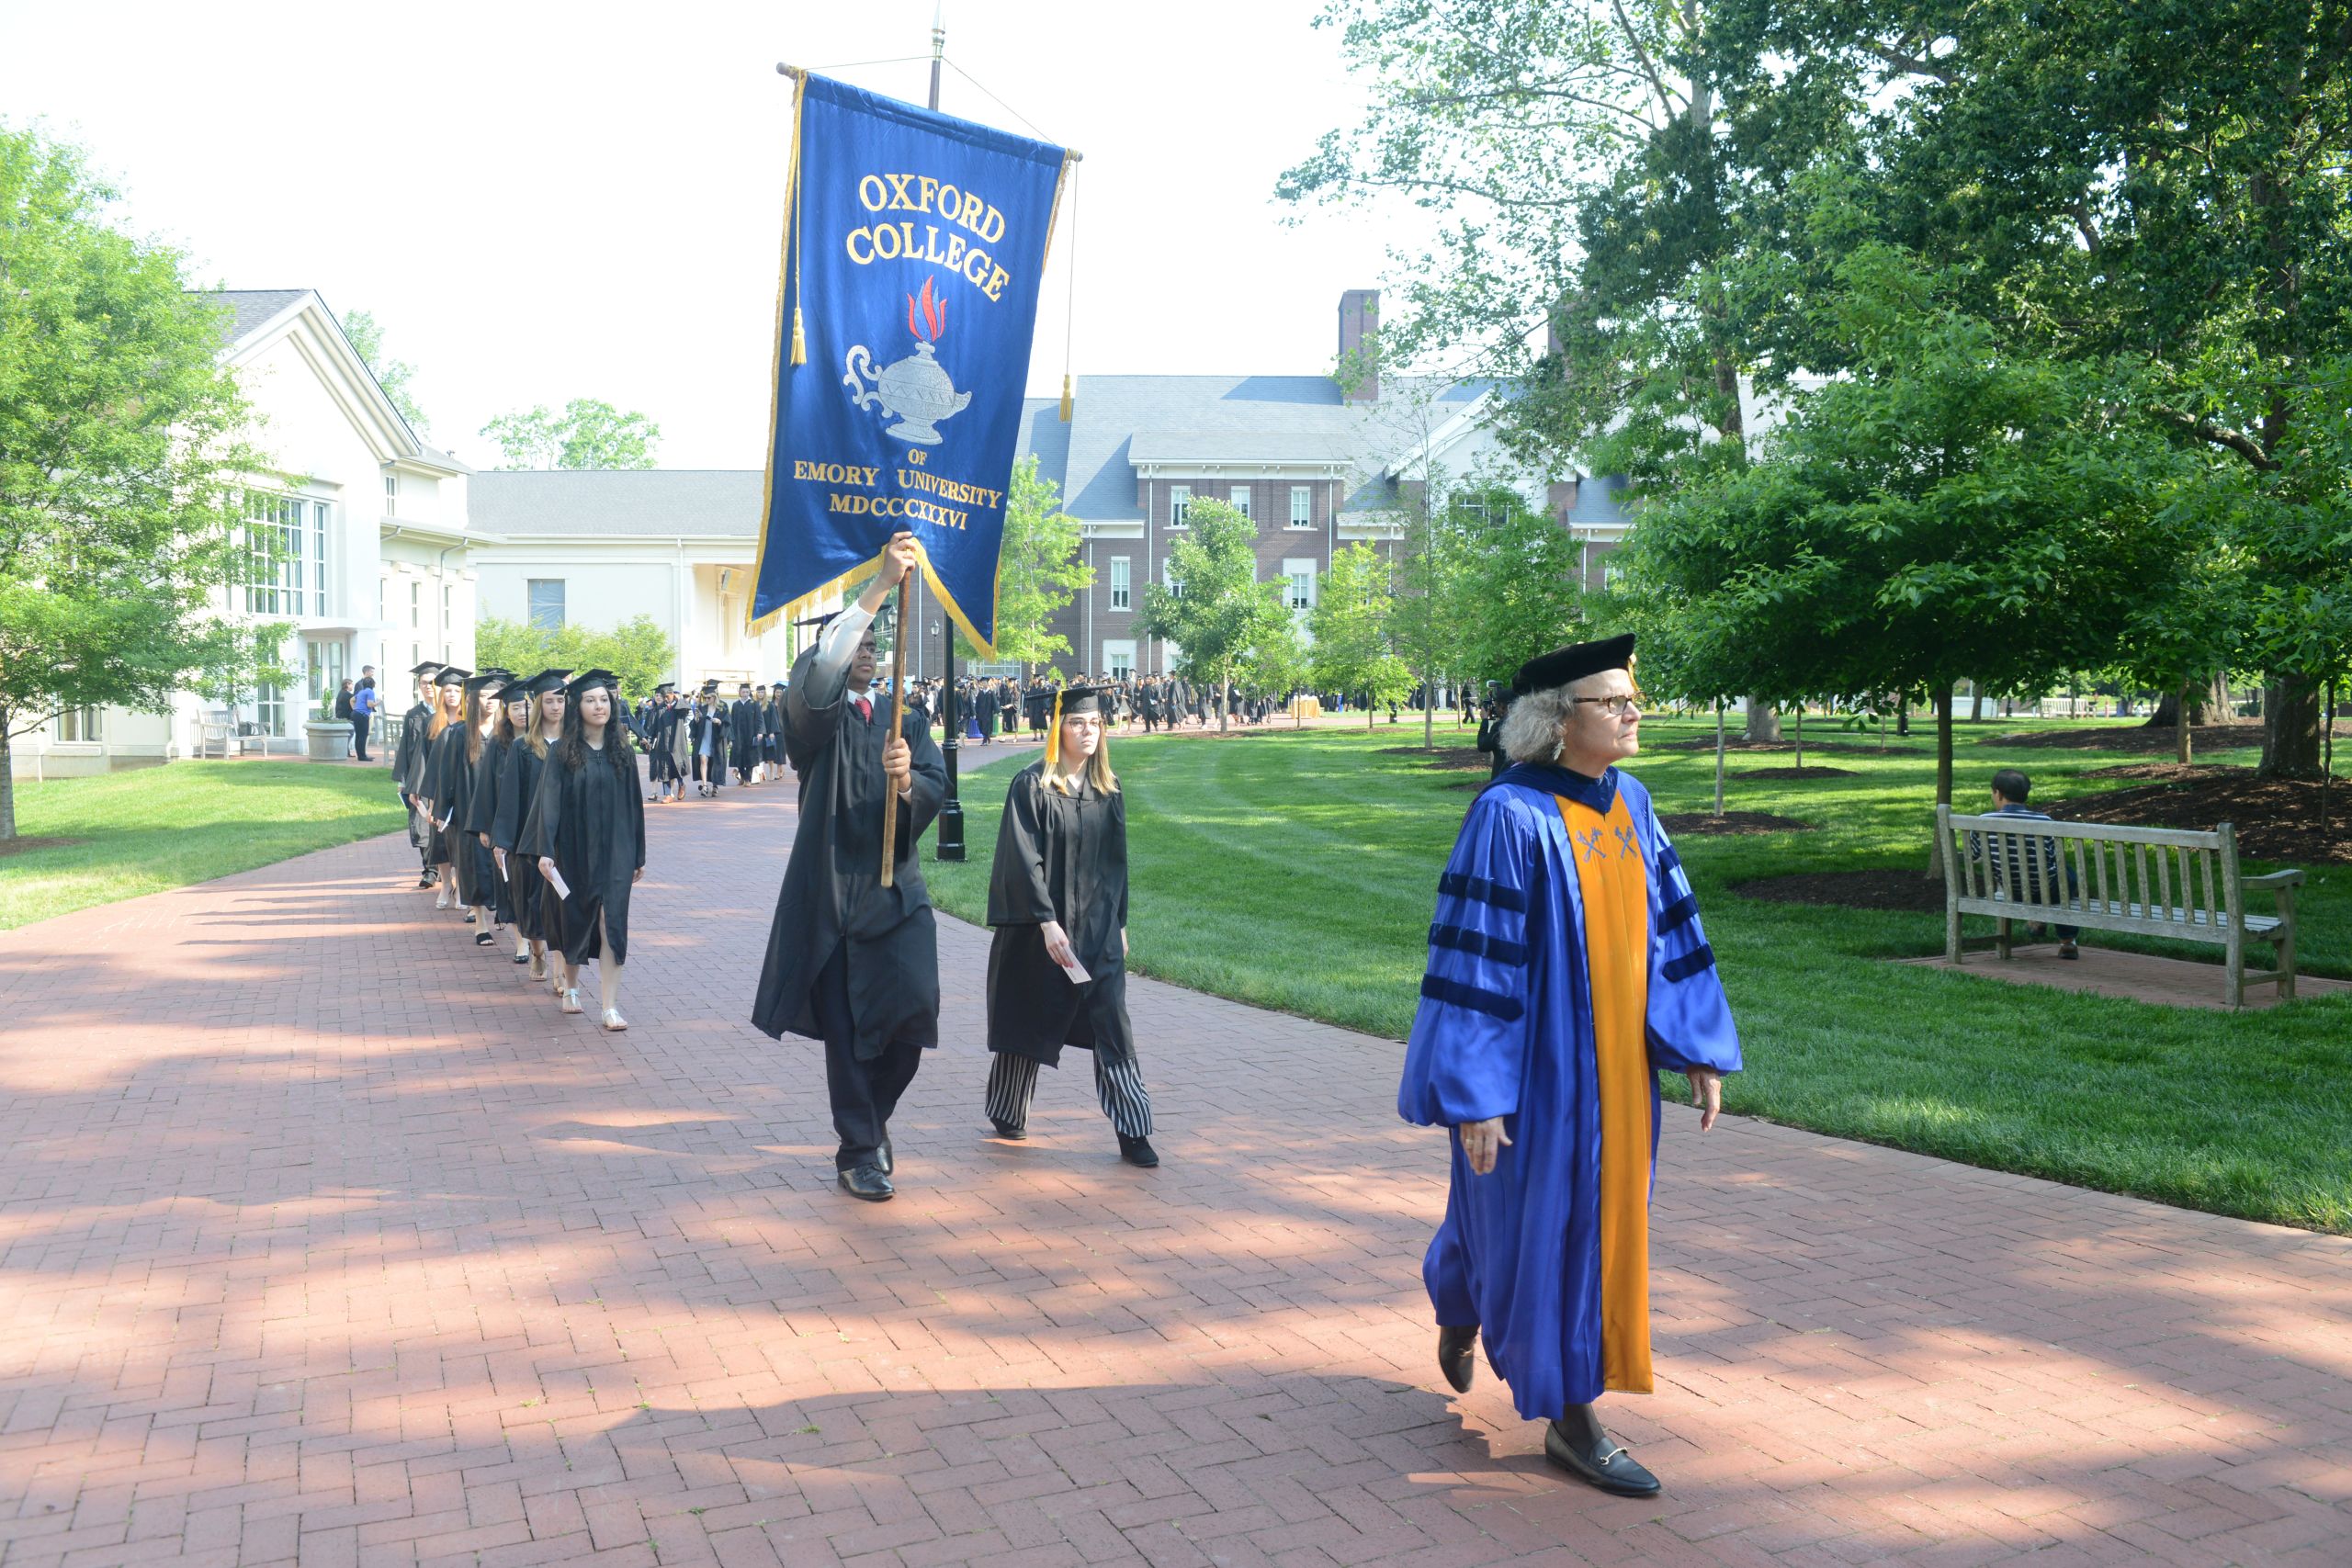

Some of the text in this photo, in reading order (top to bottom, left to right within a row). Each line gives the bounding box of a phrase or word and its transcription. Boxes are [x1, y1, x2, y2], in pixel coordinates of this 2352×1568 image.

[859, 174, 1005, 244] OXFORD
[846, 222, 1010, 302] COLLEGE
[908, 449, 928, 466] OF
[794, 460, 1003, 510] EMORY UNIVERSITY
[830, 493, 968, 531] MDCCCXXXVI
